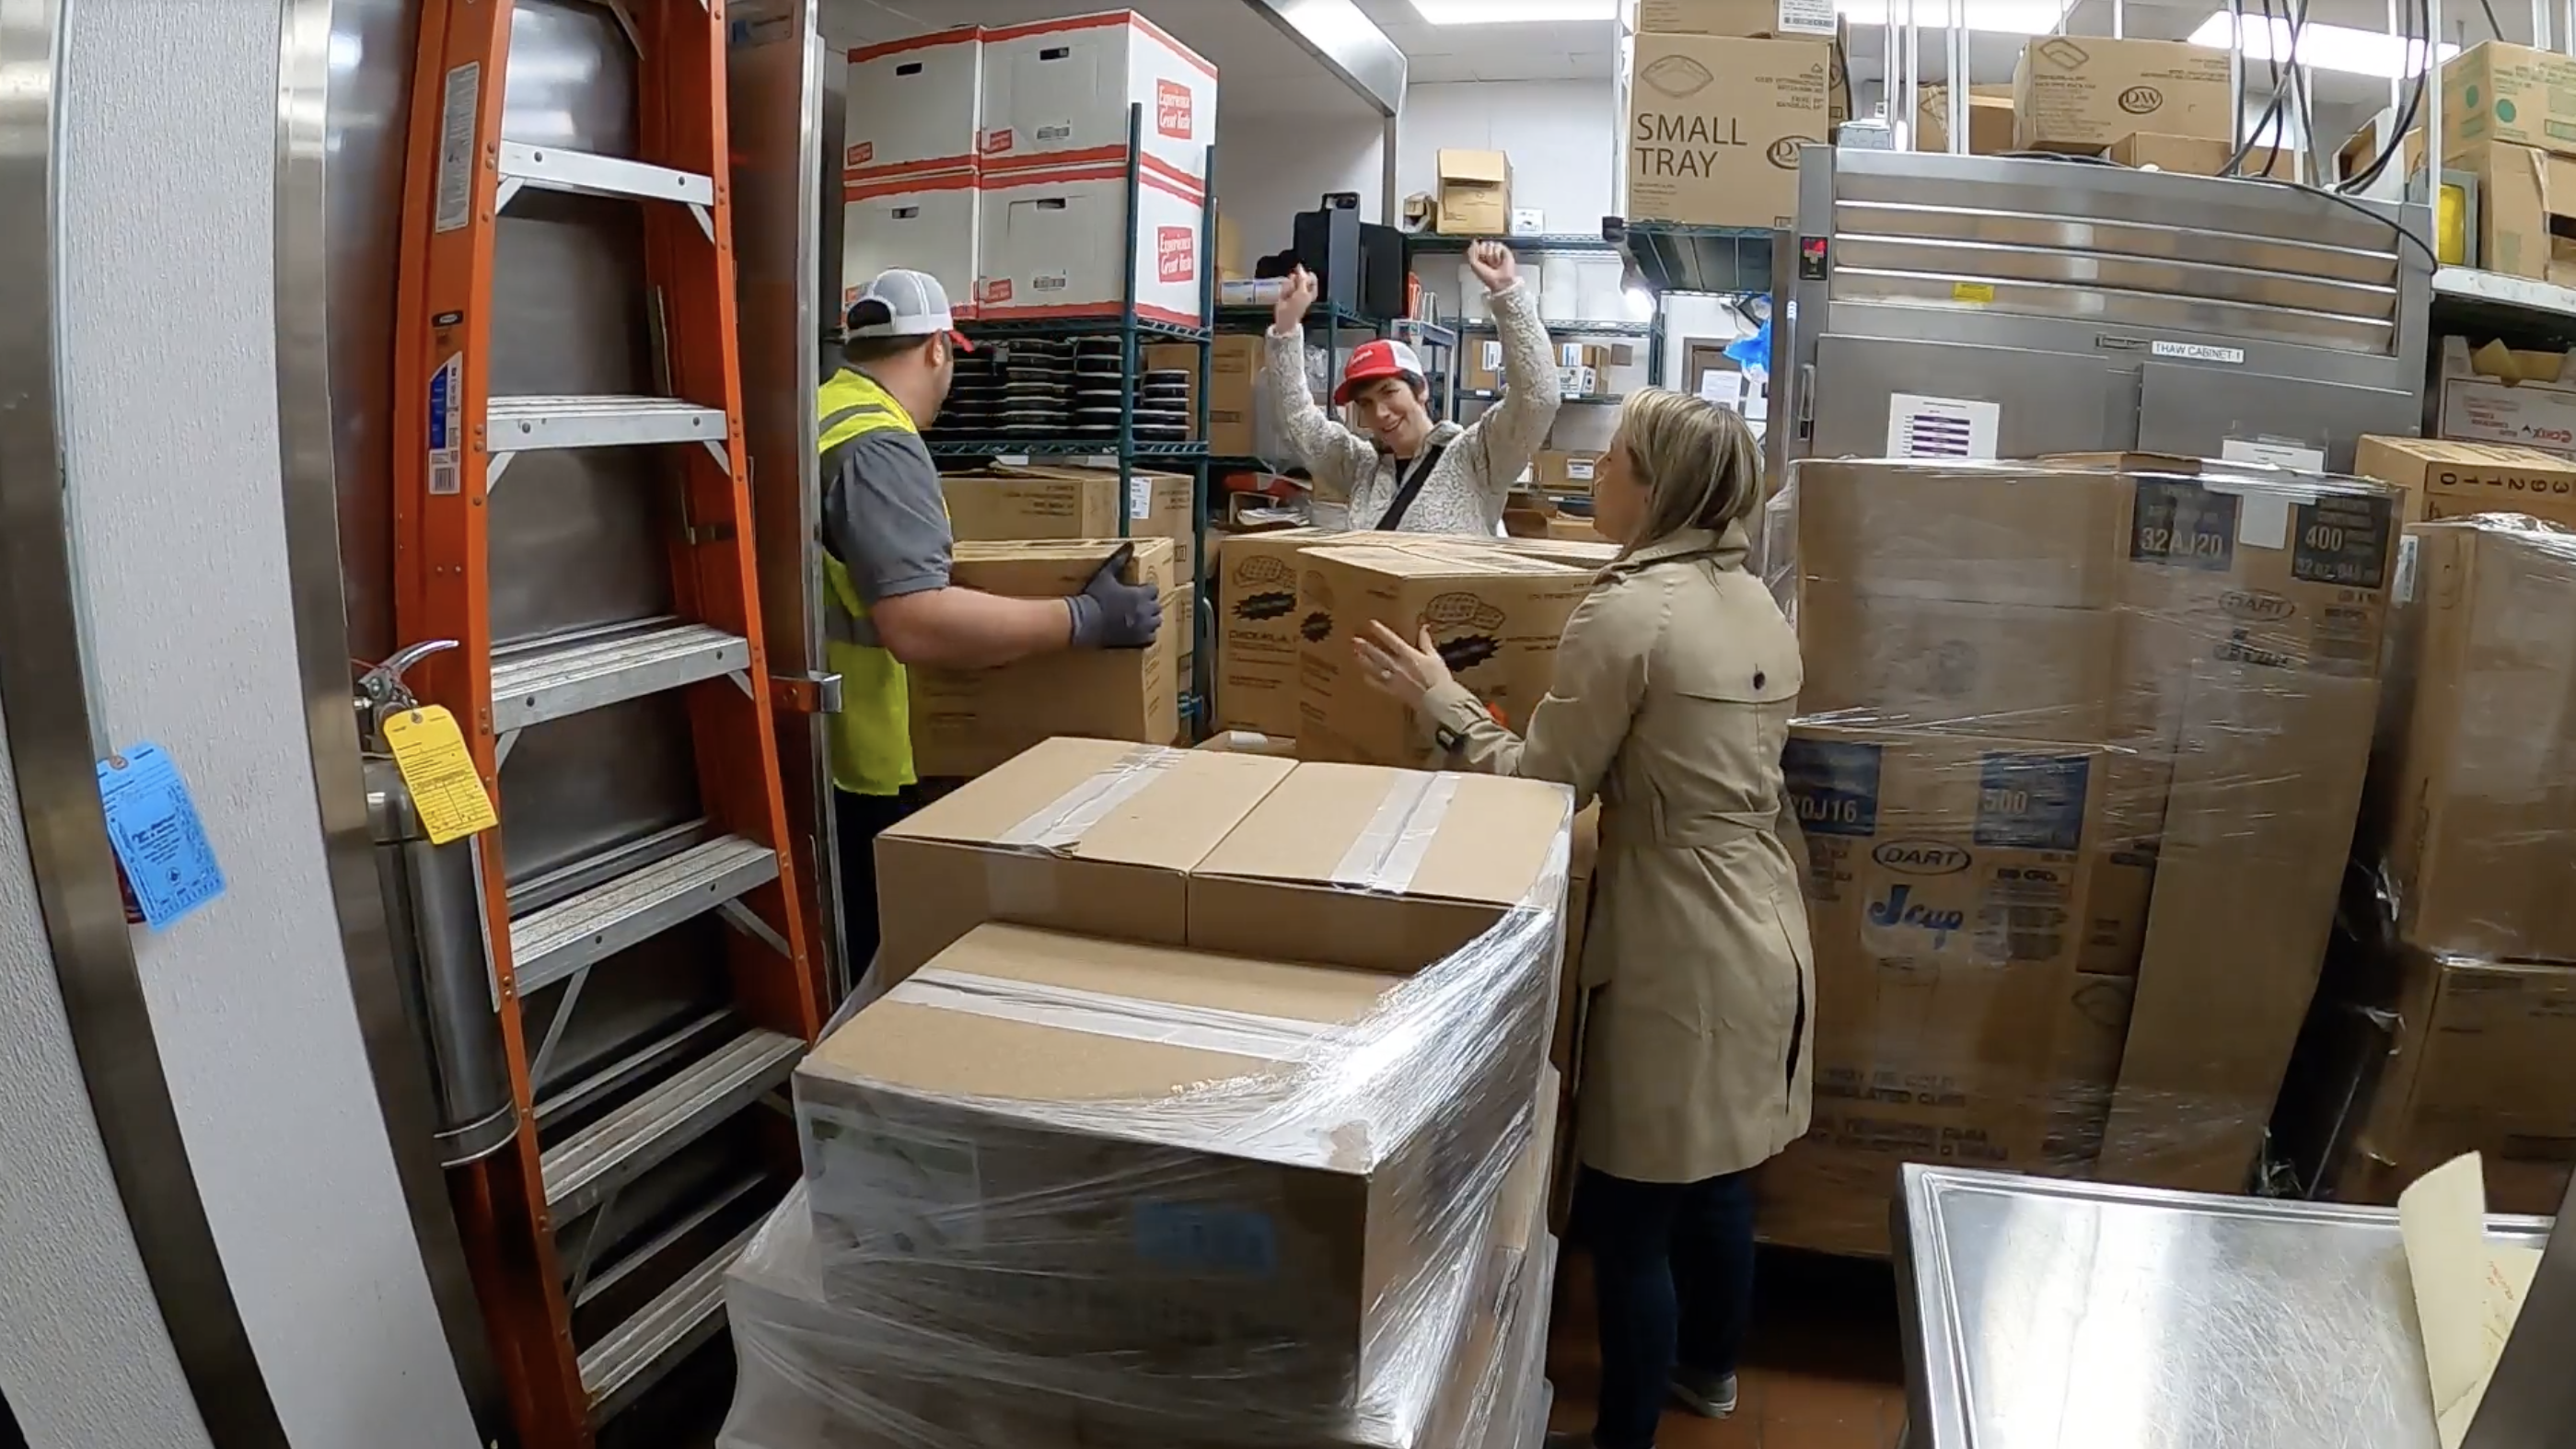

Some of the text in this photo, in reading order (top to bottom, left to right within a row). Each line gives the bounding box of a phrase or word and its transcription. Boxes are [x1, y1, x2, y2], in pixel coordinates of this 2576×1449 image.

[1159, 86, 1190, 109] Experience
[2125, 89, 2159, 104] DW
[1160, 108, 1177, 128] Great
[1637, 112, 1748, 146] SMALL
[1635, 146, 1719, 179] TRAY
[1160, 233, 1191, 253] Experience
[1161, 253, 1178, 274] Great
[2155, 342, 2186, 355] THAW
[2187, 346, 2234, 361] CABINET
[2141, 526, 2223, 559] 32AJ20
[2304, 525, 2344, 552] 400
[2226, 595, 2286, 616] DART
[1982, 787, 2028, 815] 500
[1884, 845, 1960, 868] DART
